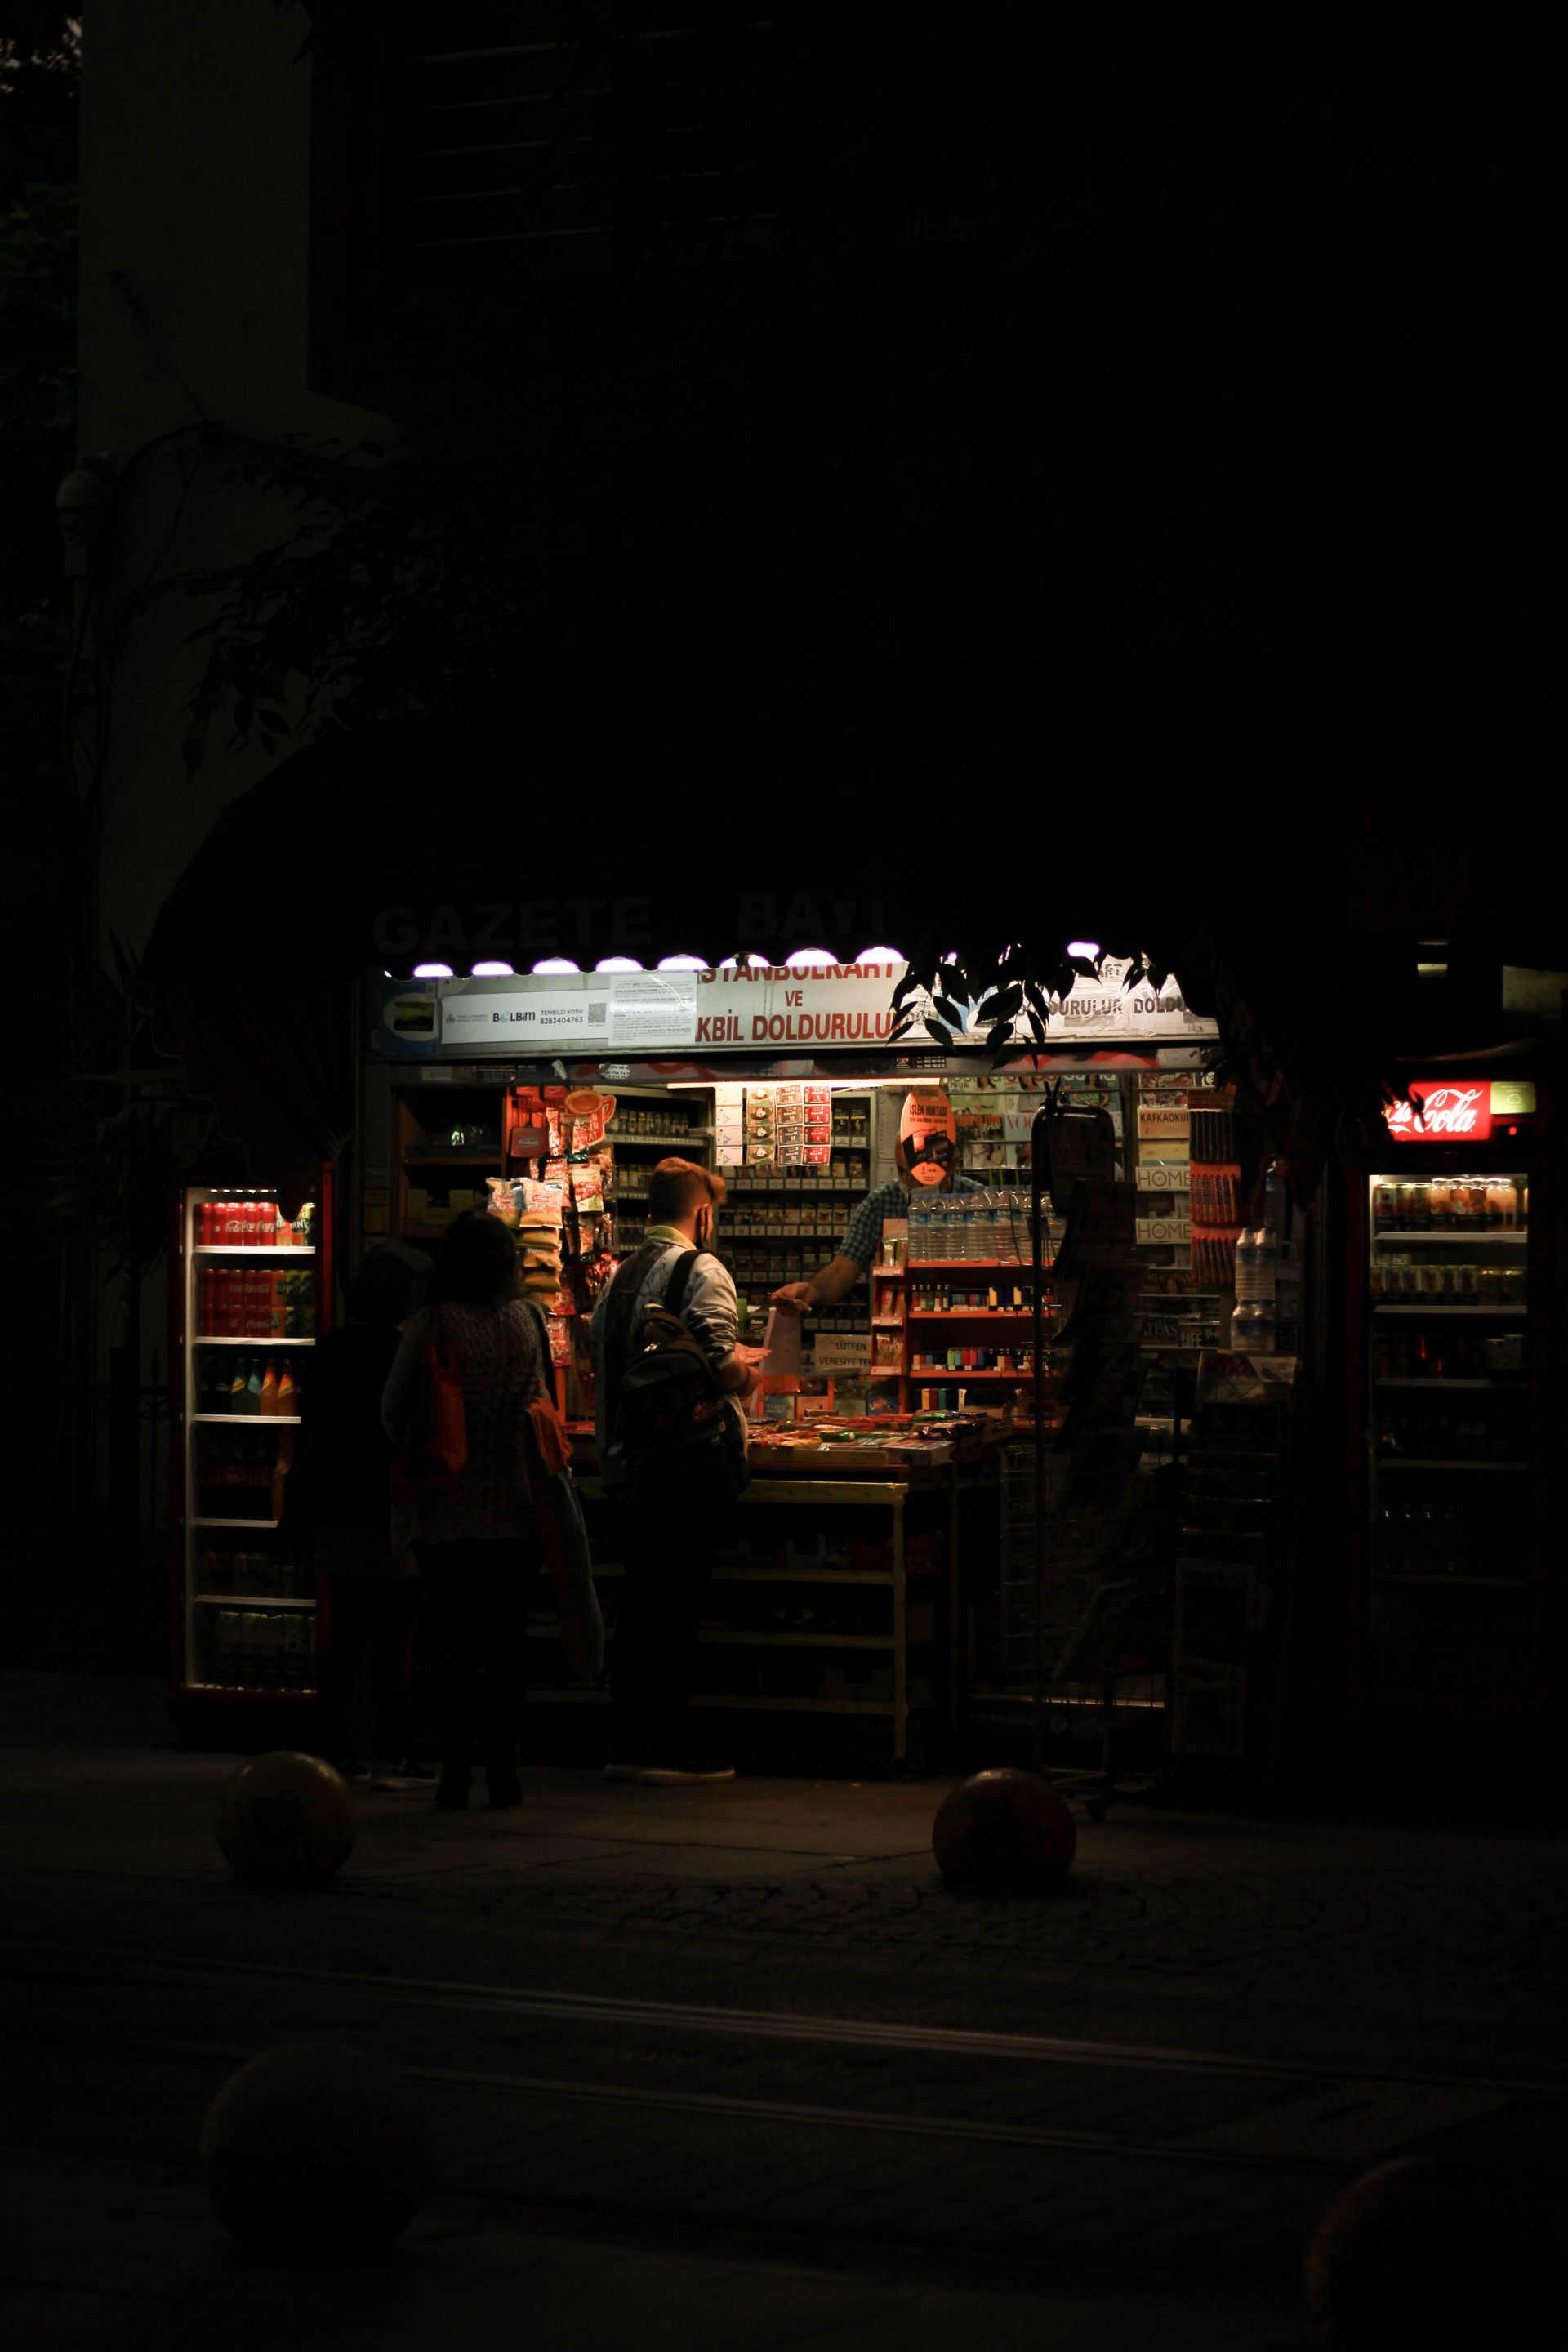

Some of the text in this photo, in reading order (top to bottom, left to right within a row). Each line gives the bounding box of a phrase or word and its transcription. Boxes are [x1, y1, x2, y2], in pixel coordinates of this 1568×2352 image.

[372, 894, 653, 954] GAZETE
[785, 990, 803, 1007] VE
[540, 1017, 583, 1025] 8283404763
[1138, 1171, 1191, 1187] HOME
[1138, 1223, 1191, 1240] HOME
